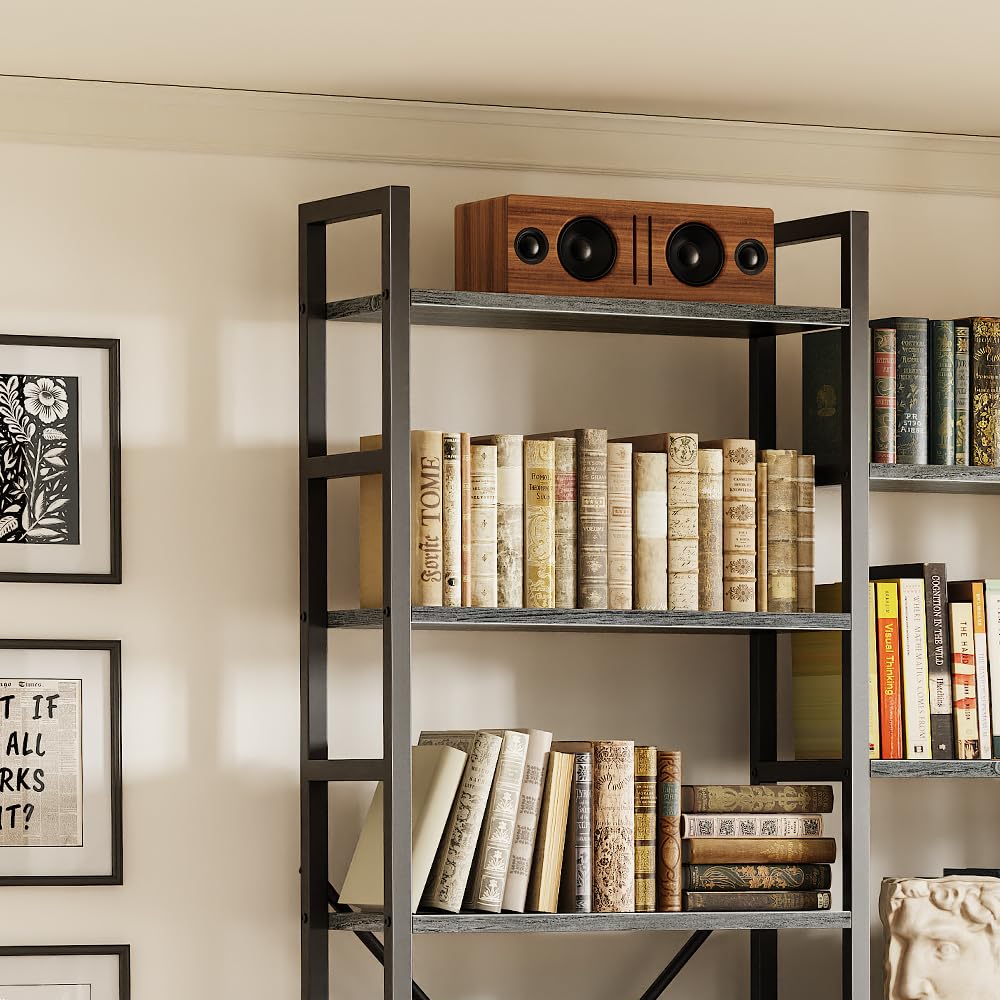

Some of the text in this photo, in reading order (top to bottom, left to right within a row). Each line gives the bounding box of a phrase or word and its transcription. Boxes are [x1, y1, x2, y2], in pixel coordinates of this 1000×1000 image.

[420, 456, 441, 527] TOME
[931, 574, 945, 666] COGNITION IN THE WILD
[959, 621, 967, 638] THE
[884, 623, 895, 654] Visual
[885, 654, 896, 696] Thinking
[32, 693, 60, 720] IF
[918, 715, 926, 740] FROM
[6, 731, 46, 757] ALL
